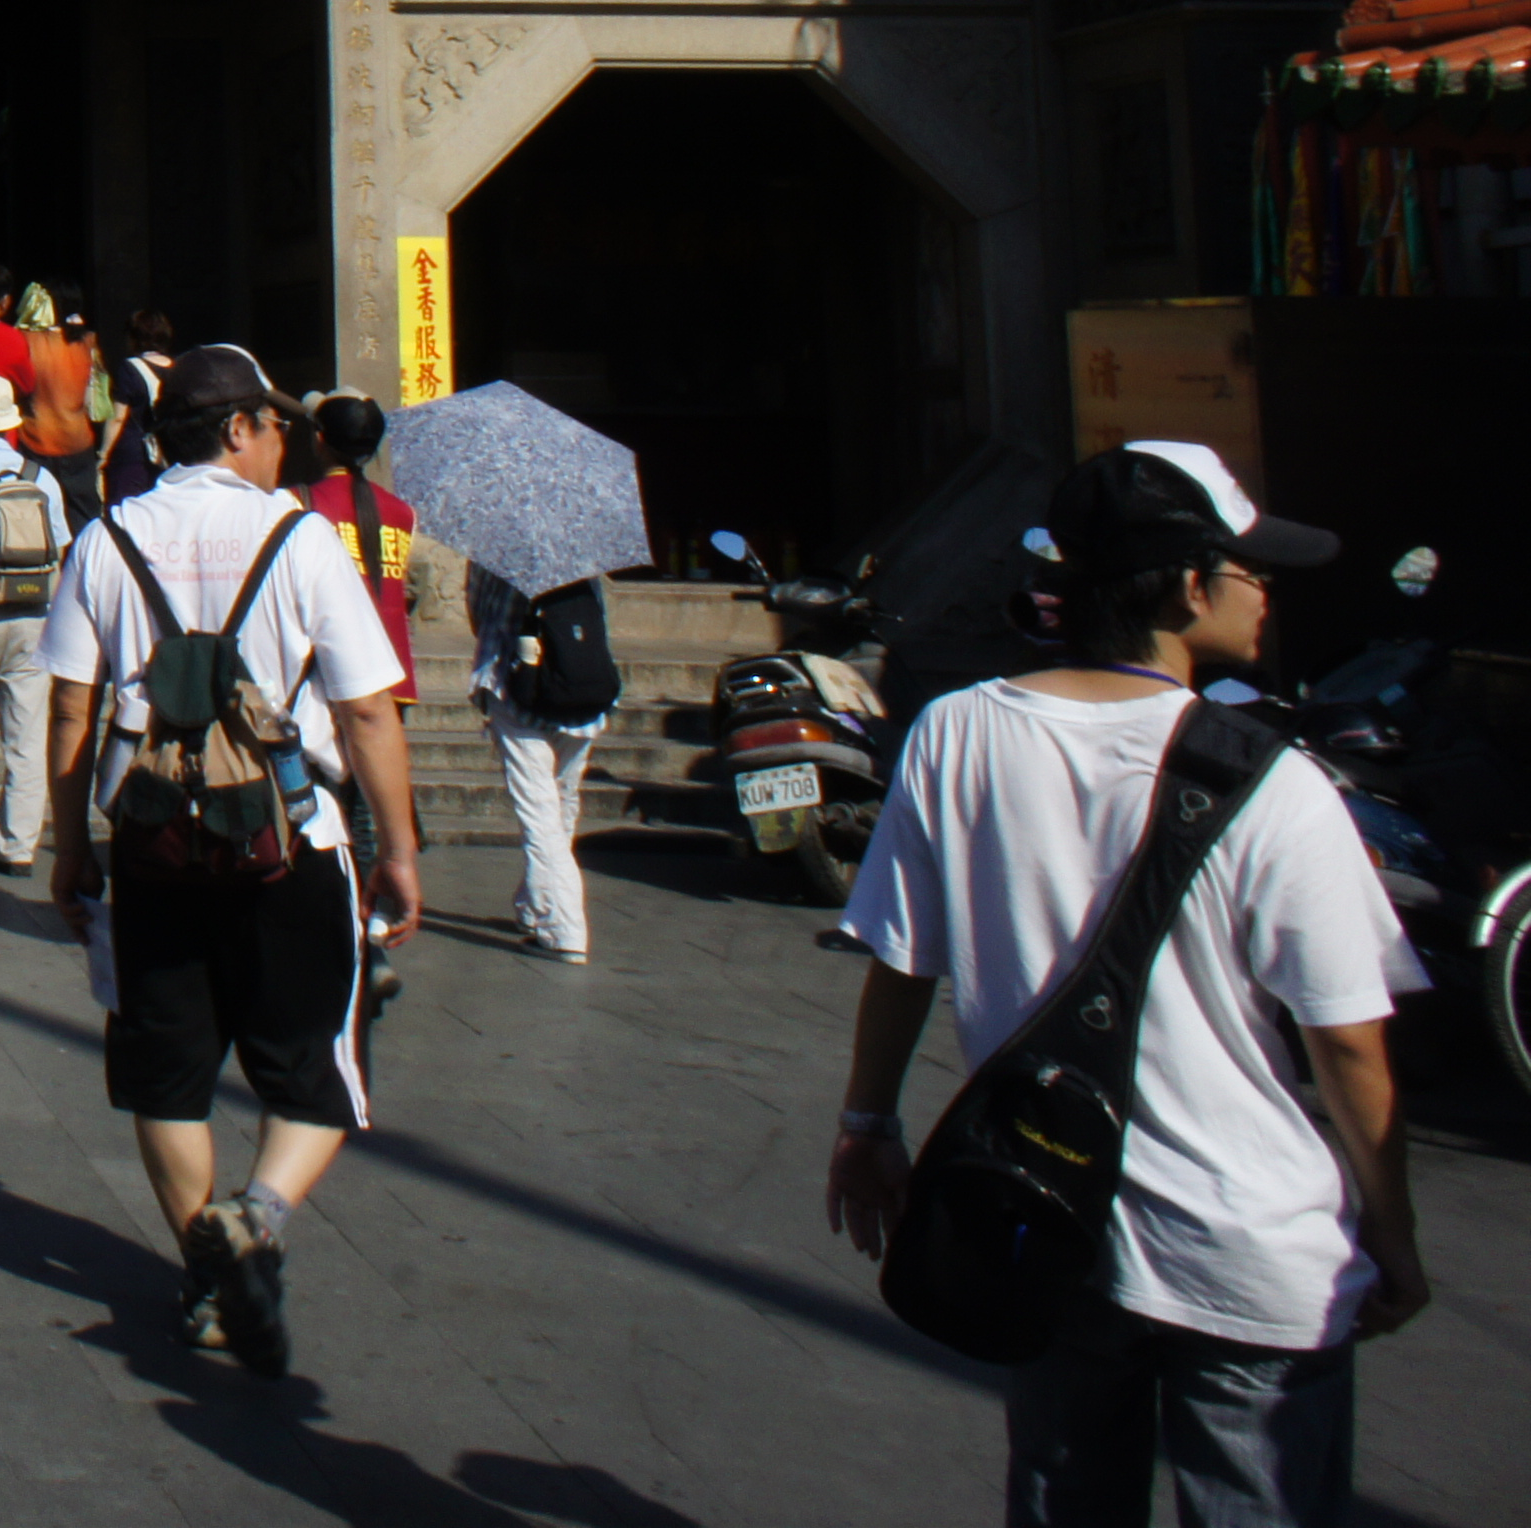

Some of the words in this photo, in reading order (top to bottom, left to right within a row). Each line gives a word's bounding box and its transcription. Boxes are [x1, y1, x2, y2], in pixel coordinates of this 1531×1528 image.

[411, 247, 443, 399] 金香服務
[189, 538, 242, 564] 2008
[738, 776, 816, 808] KUW-708
